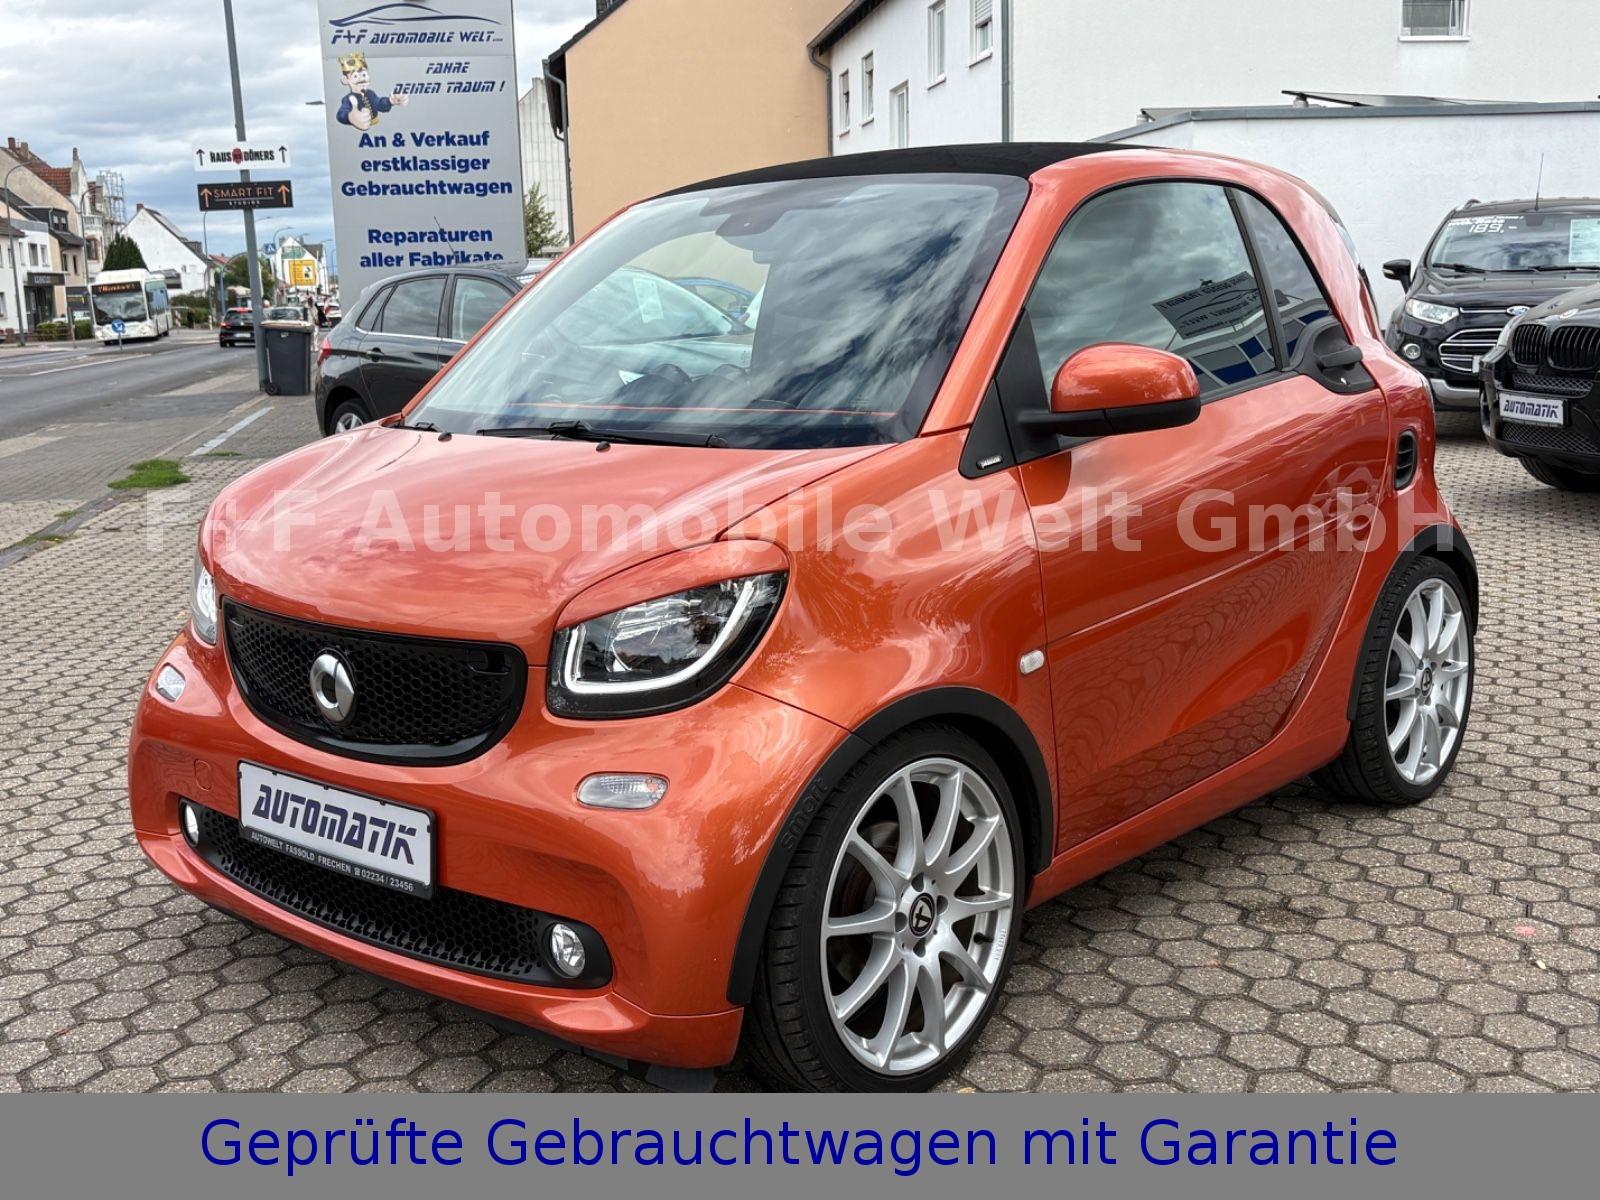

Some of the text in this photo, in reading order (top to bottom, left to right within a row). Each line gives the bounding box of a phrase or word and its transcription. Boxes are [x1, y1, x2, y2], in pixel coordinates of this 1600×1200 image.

[330, 29, 367, 44] F+F
[369, 31, 454, 44] AUTOMOBILE
[459, 30, 494, 42] WELT
[426, 62, 470, 75] FAHRE
[393, 82, 441, 95] DEINEN
[446, 81, 495, 94] TRAUM
[358, 131, 490, 148] An & Verkauf
[361, 155, 490, 173] erstklassiger
[213, 186, 274, 198] SMART FIT
[341, 180, 512, 197] Gebrauchtwagen
[368, 228, 493, 246] Reparaturen
[360, 250, 503, 268] aller Fabrikate
[1503, 400, 1559, 418] AUTOMATIK
[252, 784, 417, 865] AUTOMATIK
[251, 831, 284, 850] AUTOWELT
[285, 844, 315, 861] FASSOLD
[318, 855, 351, 873] FRECHEN
[361, 868, 384, 884] 02234
[389, 877, 414, 892] 23456
